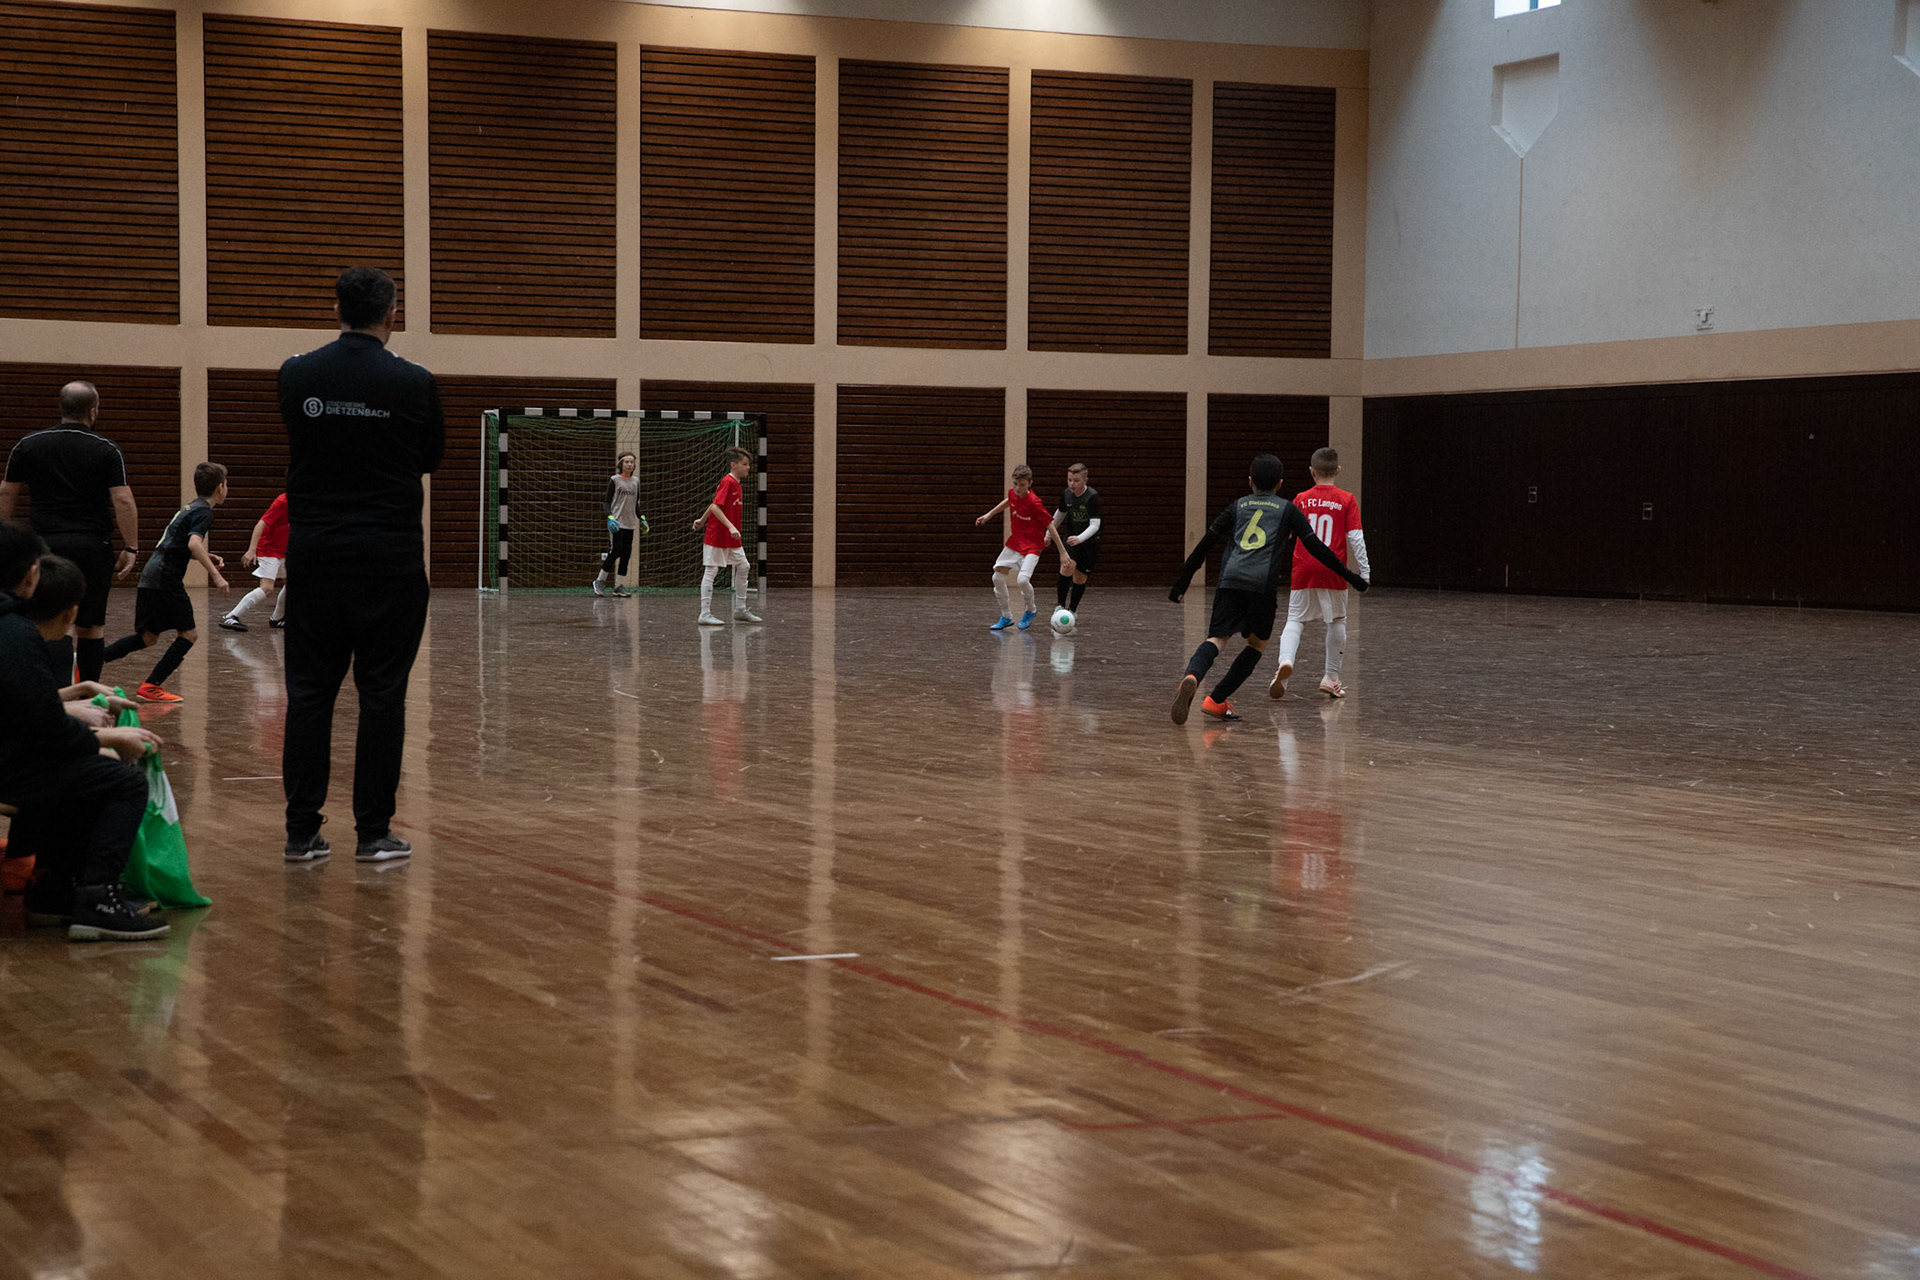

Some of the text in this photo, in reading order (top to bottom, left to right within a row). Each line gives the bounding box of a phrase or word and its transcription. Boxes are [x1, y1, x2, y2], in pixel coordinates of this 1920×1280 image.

[326, 406, 391, 418] DIETZENBACH
[1308, 498, 1317, 507] FC
[1318, 498, 1343, 511] Langen
[1239, 508, 1267, 551] 6
[1308, 513, 1334, 547] 10
